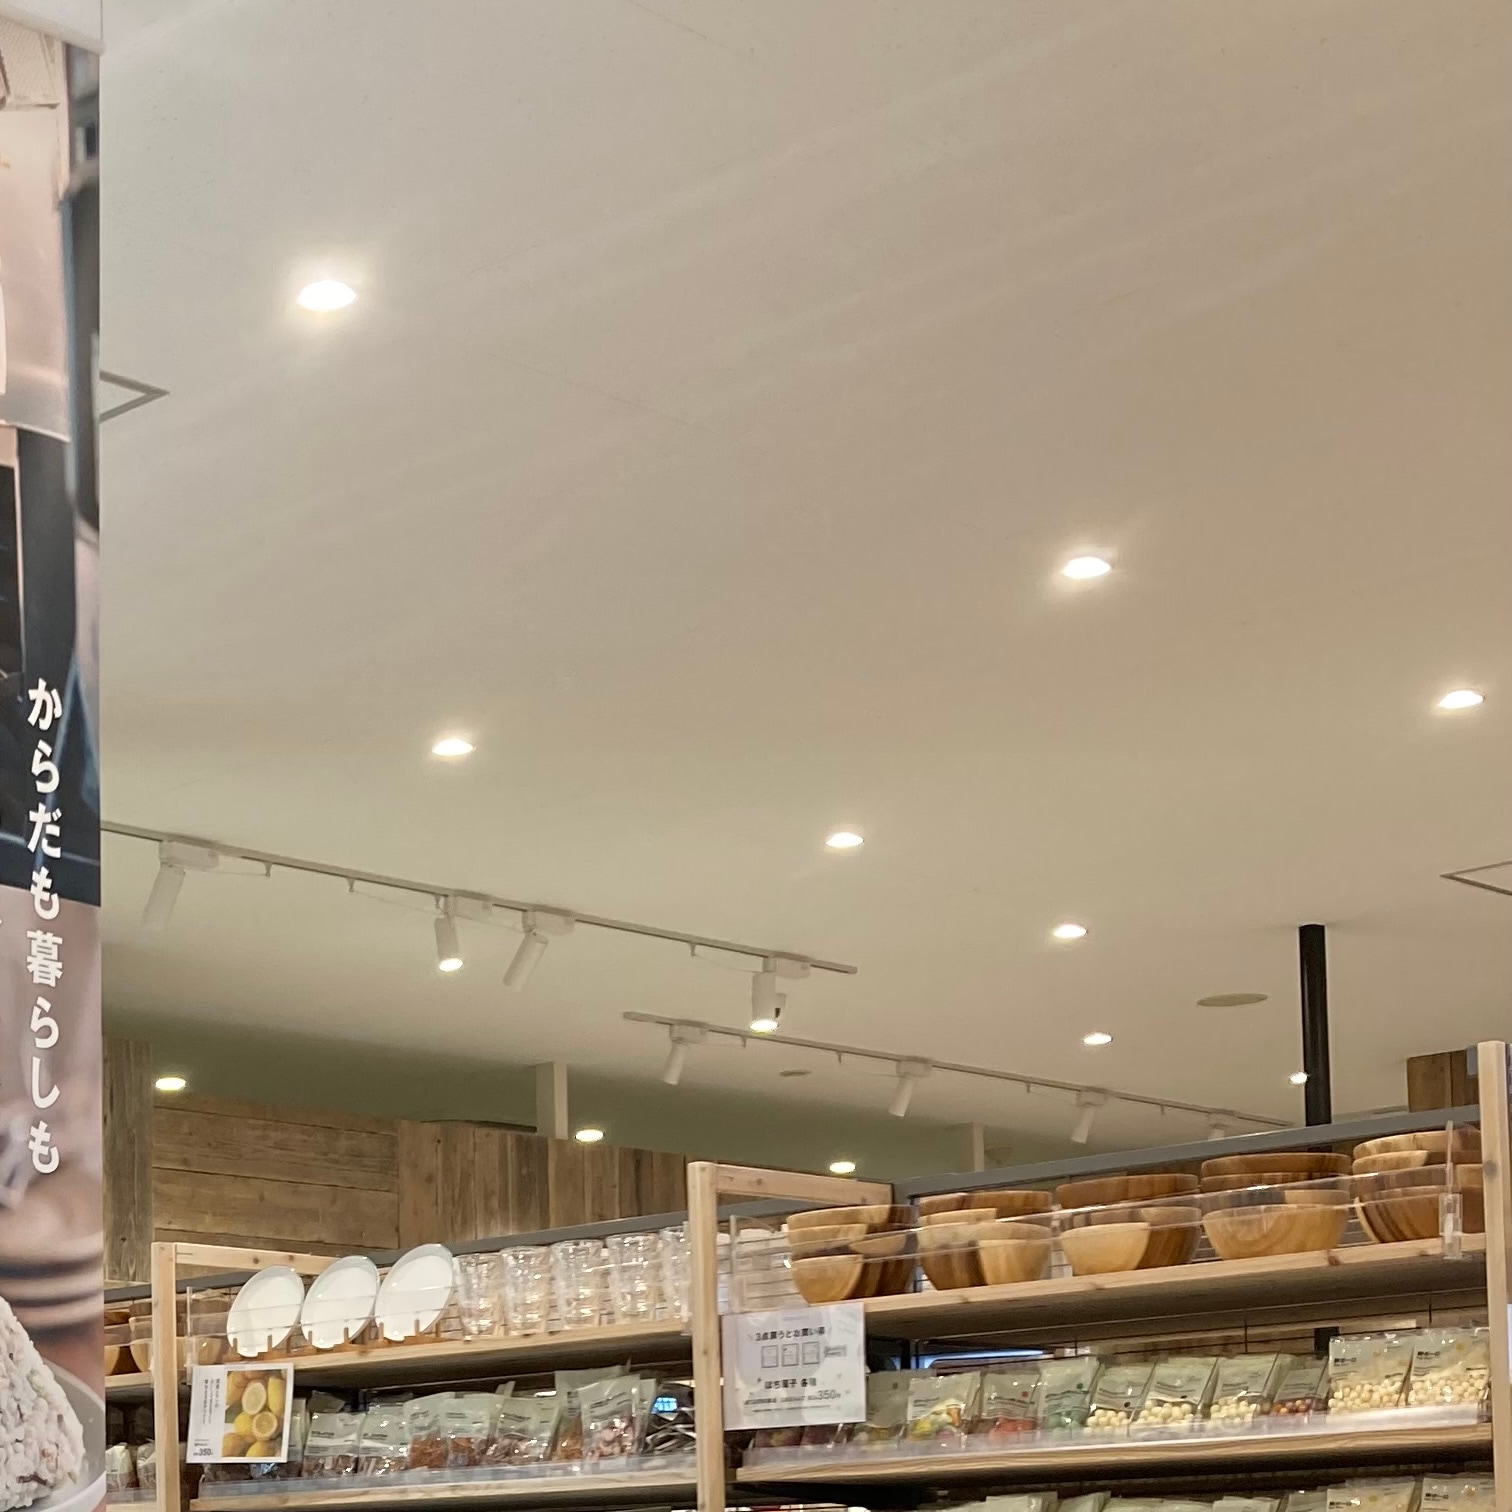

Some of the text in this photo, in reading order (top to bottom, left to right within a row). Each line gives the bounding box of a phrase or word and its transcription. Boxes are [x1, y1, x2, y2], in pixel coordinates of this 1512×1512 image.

[26, 677, 64, 1175] からだも暮らしも
